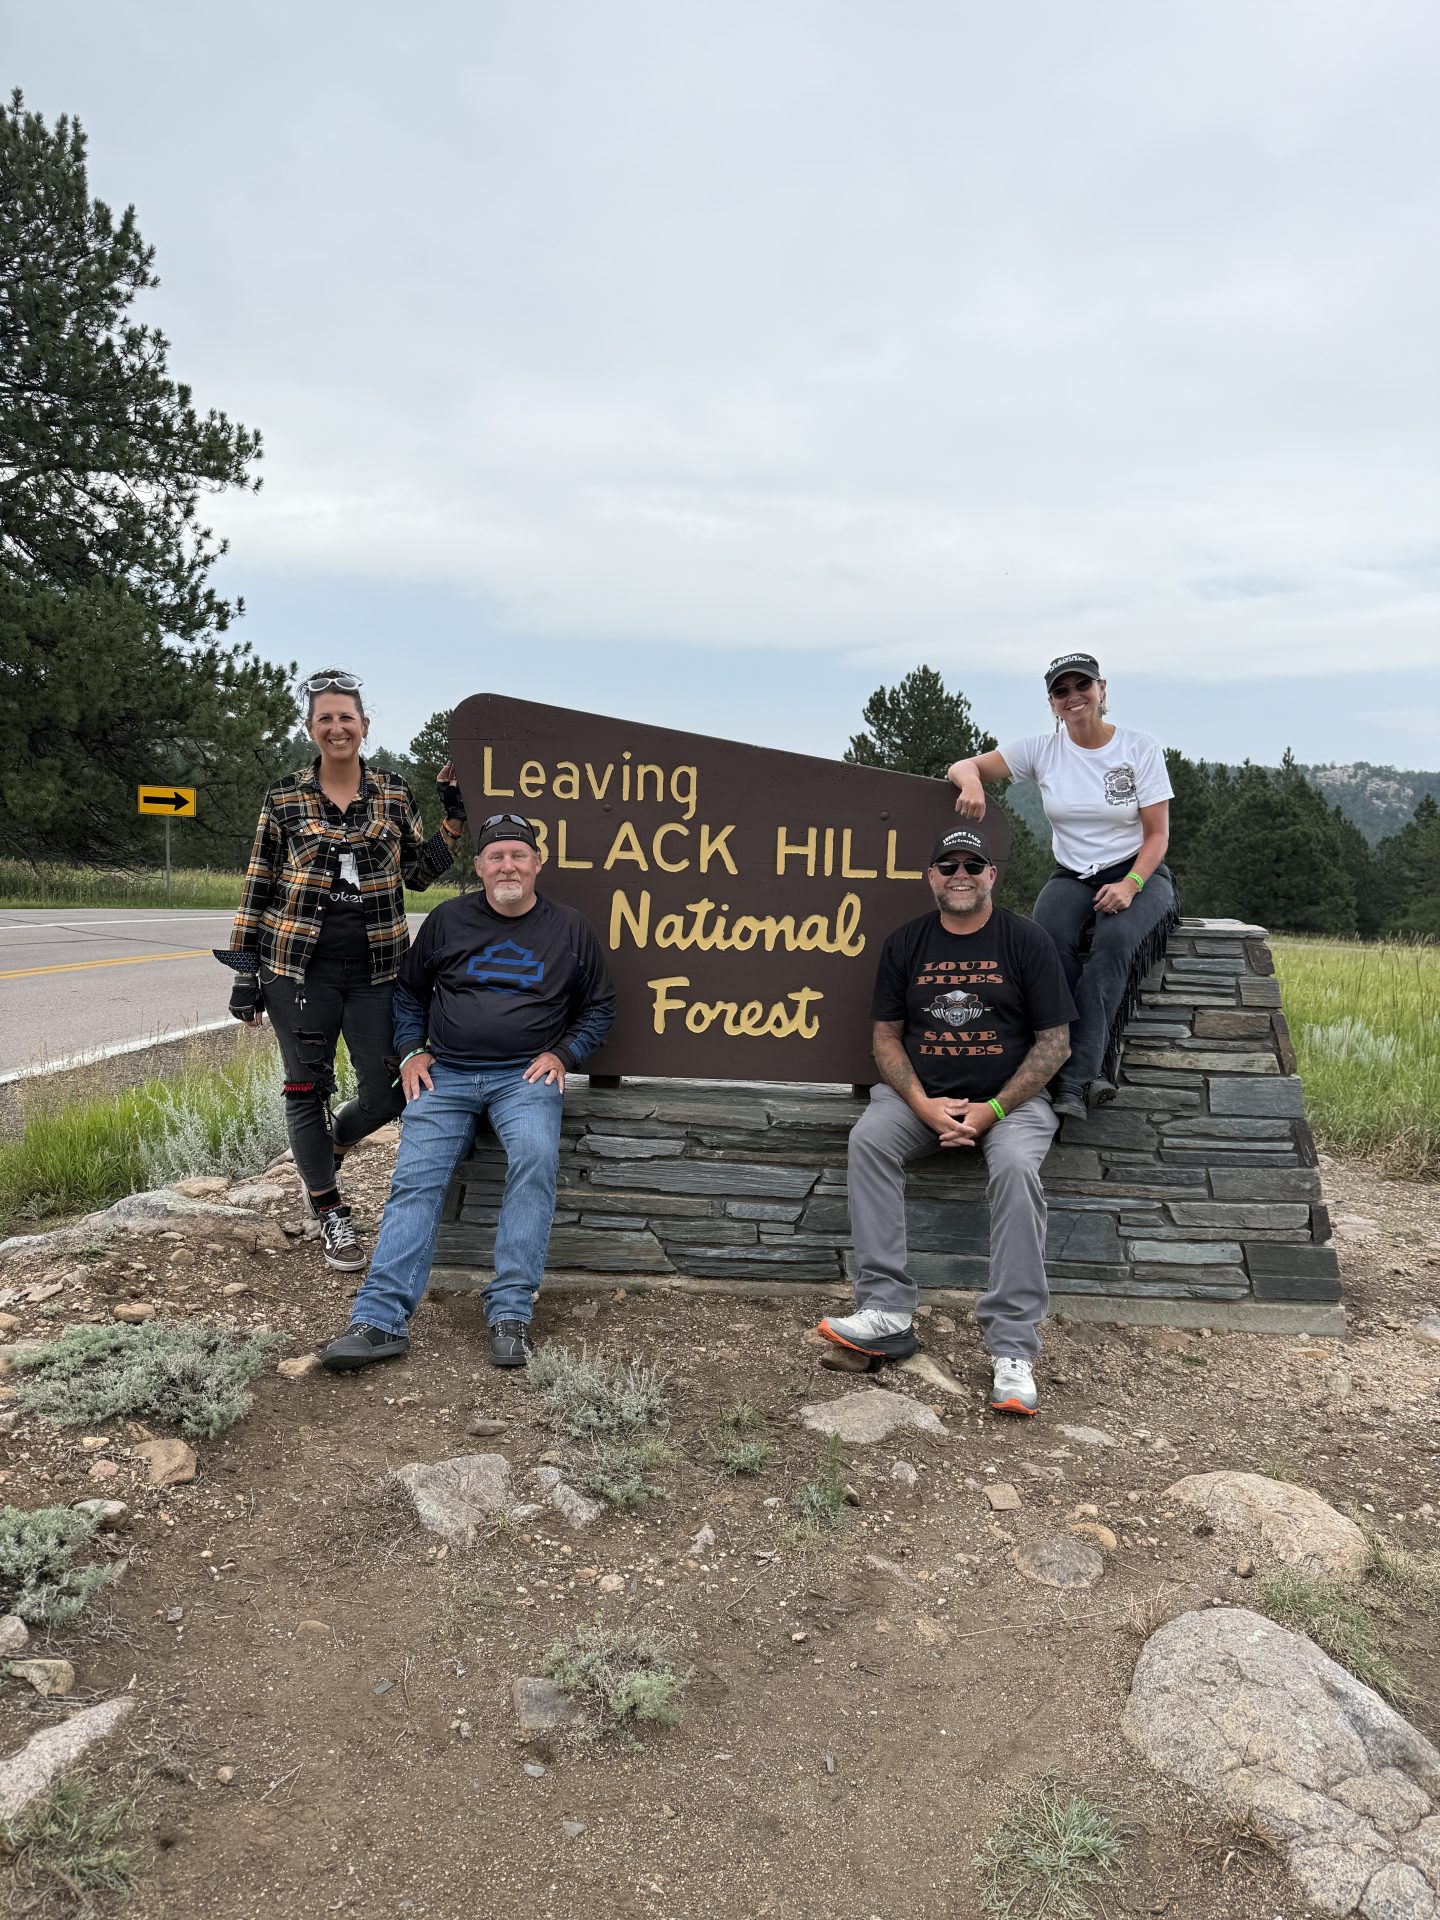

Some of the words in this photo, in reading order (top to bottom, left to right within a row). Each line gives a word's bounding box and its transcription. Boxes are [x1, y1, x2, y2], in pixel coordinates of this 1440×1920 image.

[483, 747, 697, 821] Leaving
[776, 826, 923, 880] HILL
[609, 889, 866, 957] National
[914, 974, 1004, 985] PIPES
[923, 960, 998, 971] LOUD
[646, 976, 824, 1039] Forest
[919, 1044, 1004, 1056] LIVES
[924, 1031, 997, 1042] SAVE
